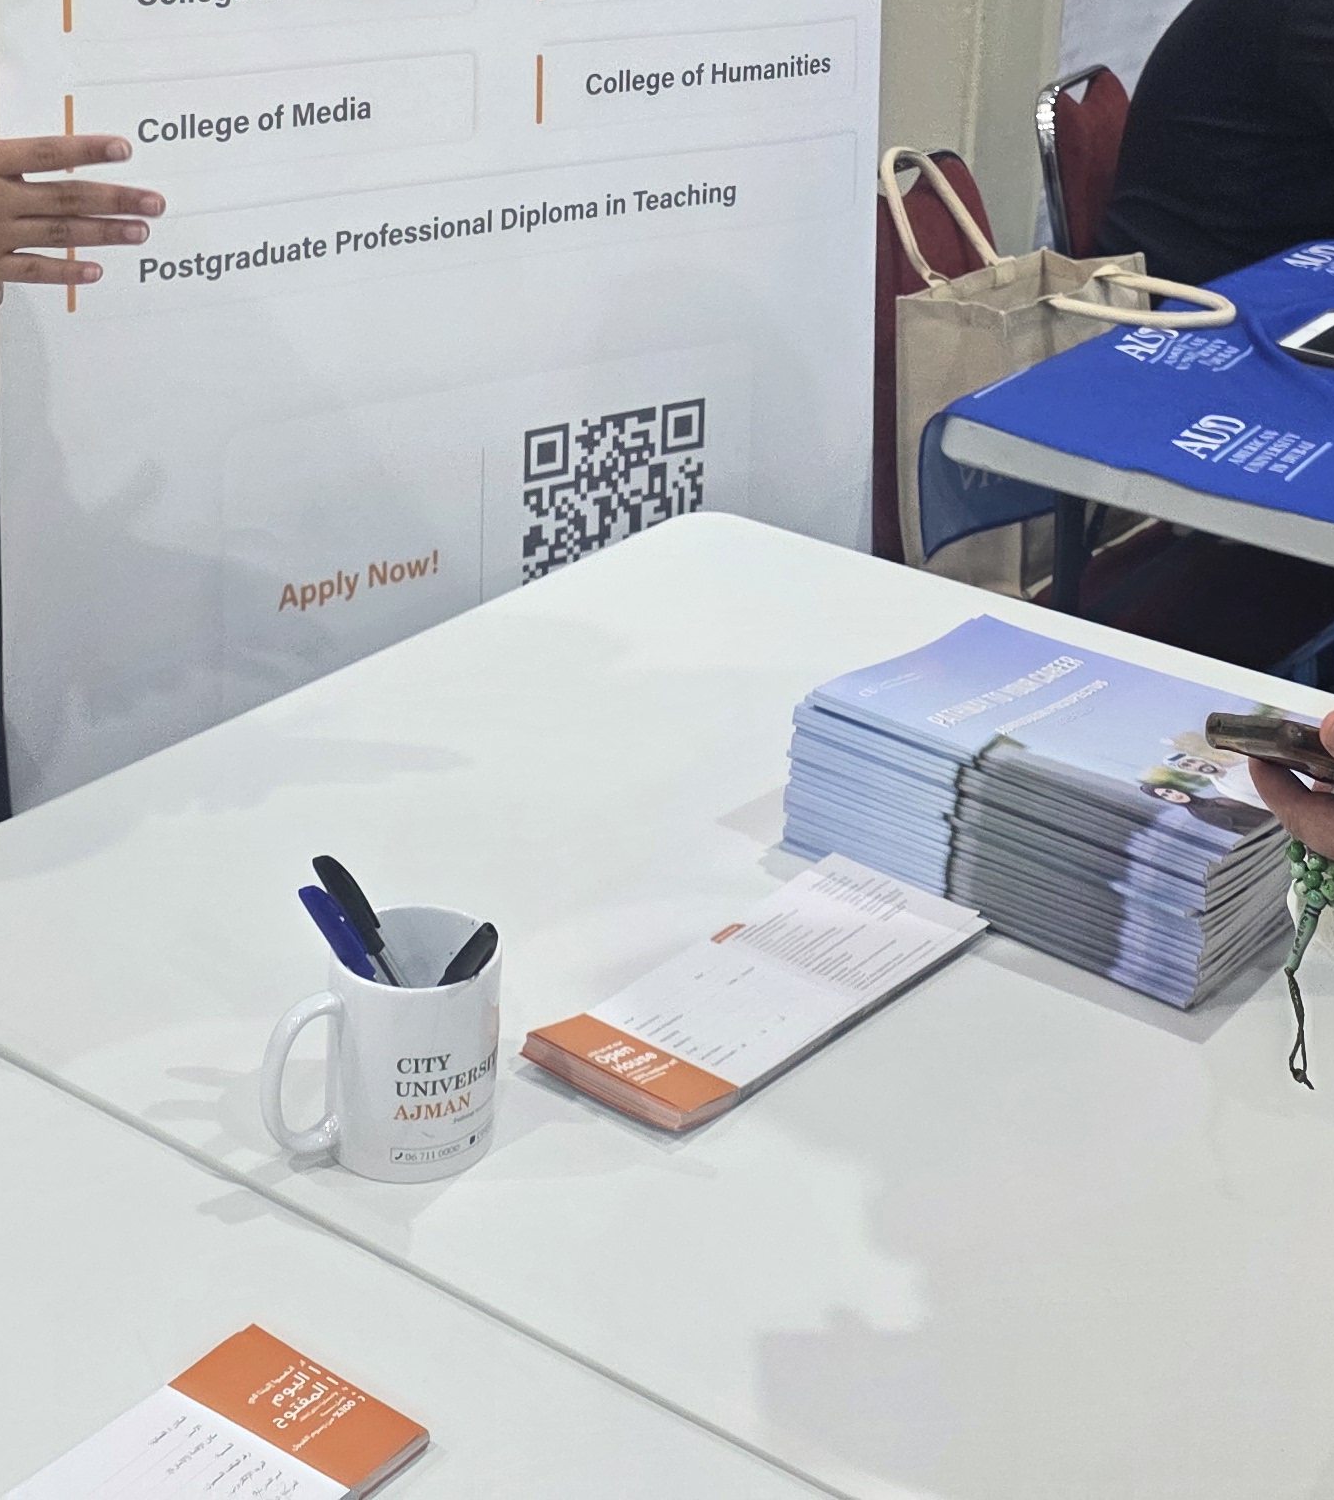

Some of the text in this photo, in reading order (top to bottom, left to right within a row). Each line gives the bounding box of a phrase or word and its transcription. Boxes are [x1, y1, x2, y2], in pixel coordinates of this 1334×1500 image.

[585, 53, 831, 96] College of Humanities
[138, 96, 371, 143] College of Media
[138, 181, 737, 283] Postgraduate Professional Diploma in Teaching
[1171, 414, 1246, 460] AUD
[278, 549, 439, 612] Apply Now!
[396, 1053, 452, 1075] CITY
[393, 1091, 472, 1121] AJMAN
[271, 1371, 311, 1408] اليوم
[272, 1381, 329, 1429] المفتوح
